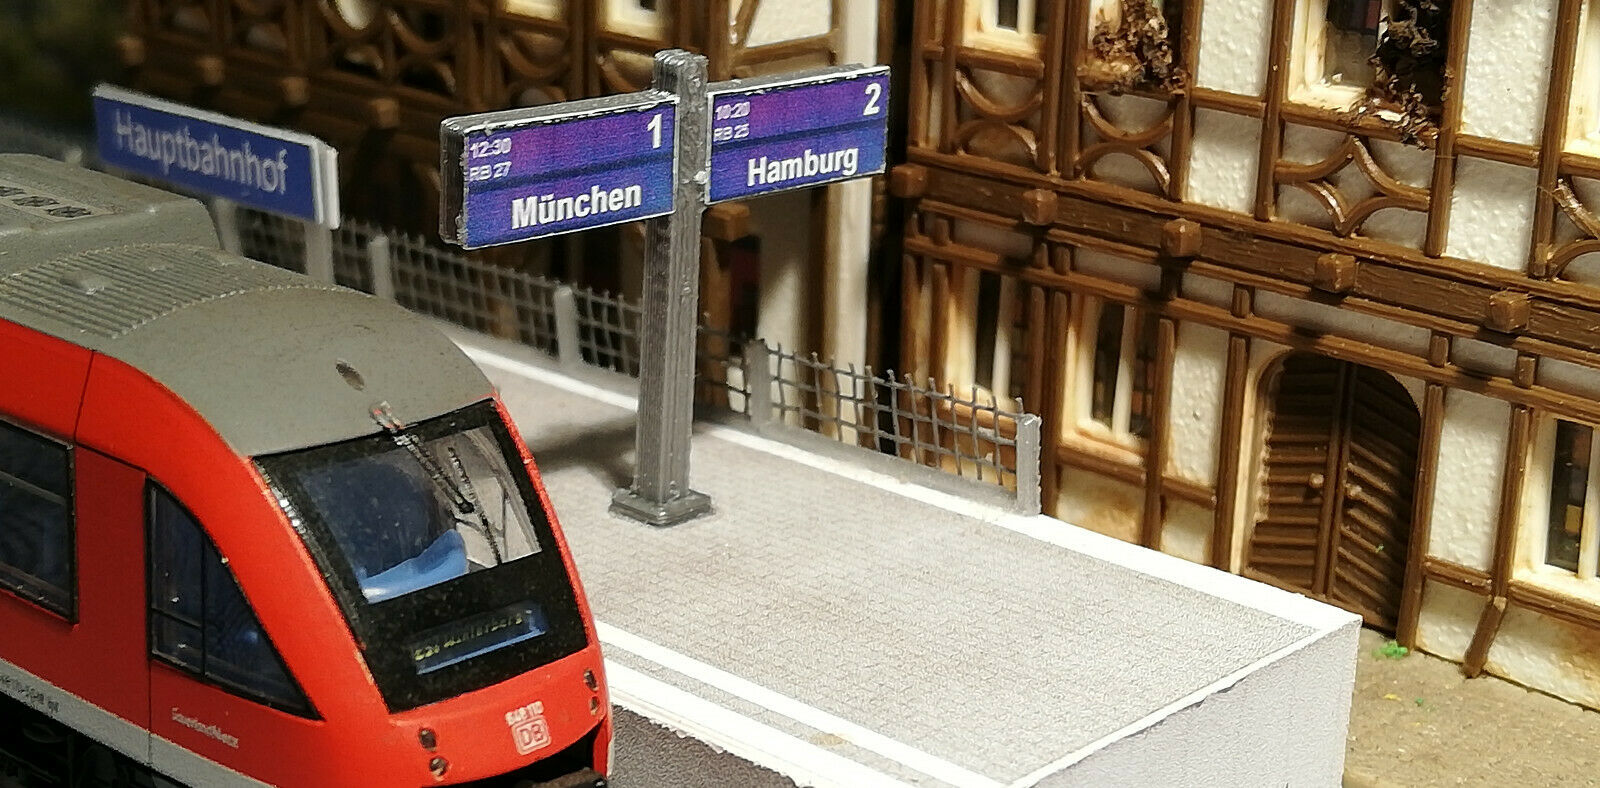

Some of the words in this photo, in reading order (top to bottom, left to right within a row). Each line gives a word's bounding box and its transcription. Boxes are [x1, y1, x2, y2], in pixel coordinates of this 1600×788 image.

[862, 82, 881, 116] 2
[469, 137, 512, 159] 12:30
[646, 113, 663, 149] 1
[114, 108, 289, 196] Hauptbahnhof
[493, 160, 513, 178] 27
[746, 146, 859, 188] Hamburg
[510, 183, 642, 230] München
